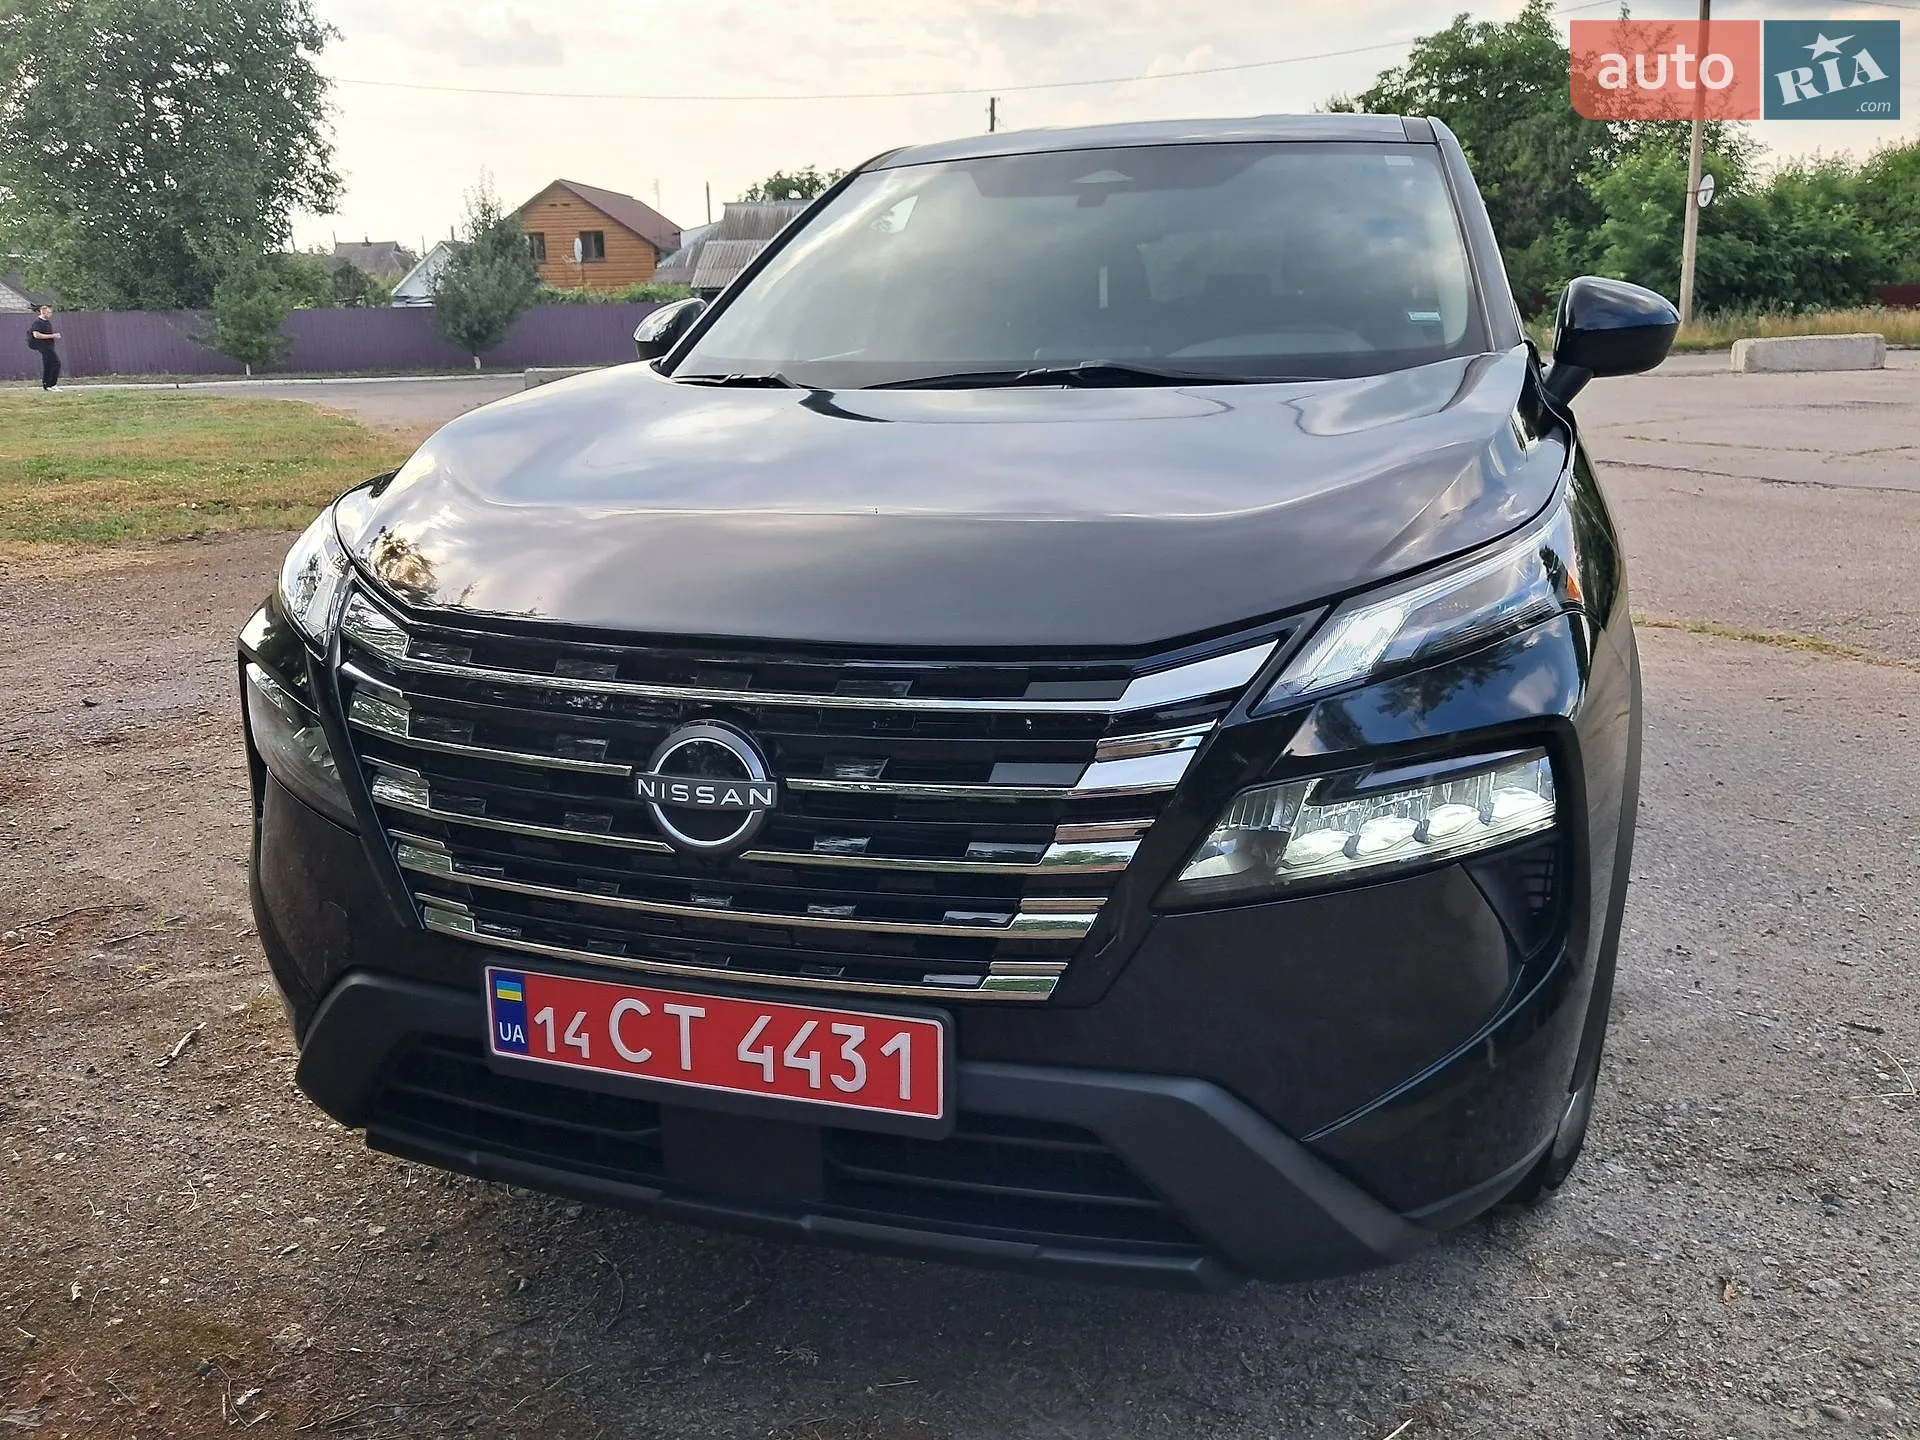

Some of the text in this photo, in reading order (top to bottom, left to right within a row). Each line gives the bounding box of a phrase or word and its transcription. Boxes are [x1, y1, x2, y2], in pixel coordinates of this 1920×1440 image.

[637, 778, 772, 806] NISSAN
[499, 1021, 525, 1044] UA
[534, 998, 912, 1101] 14 CT 4431
